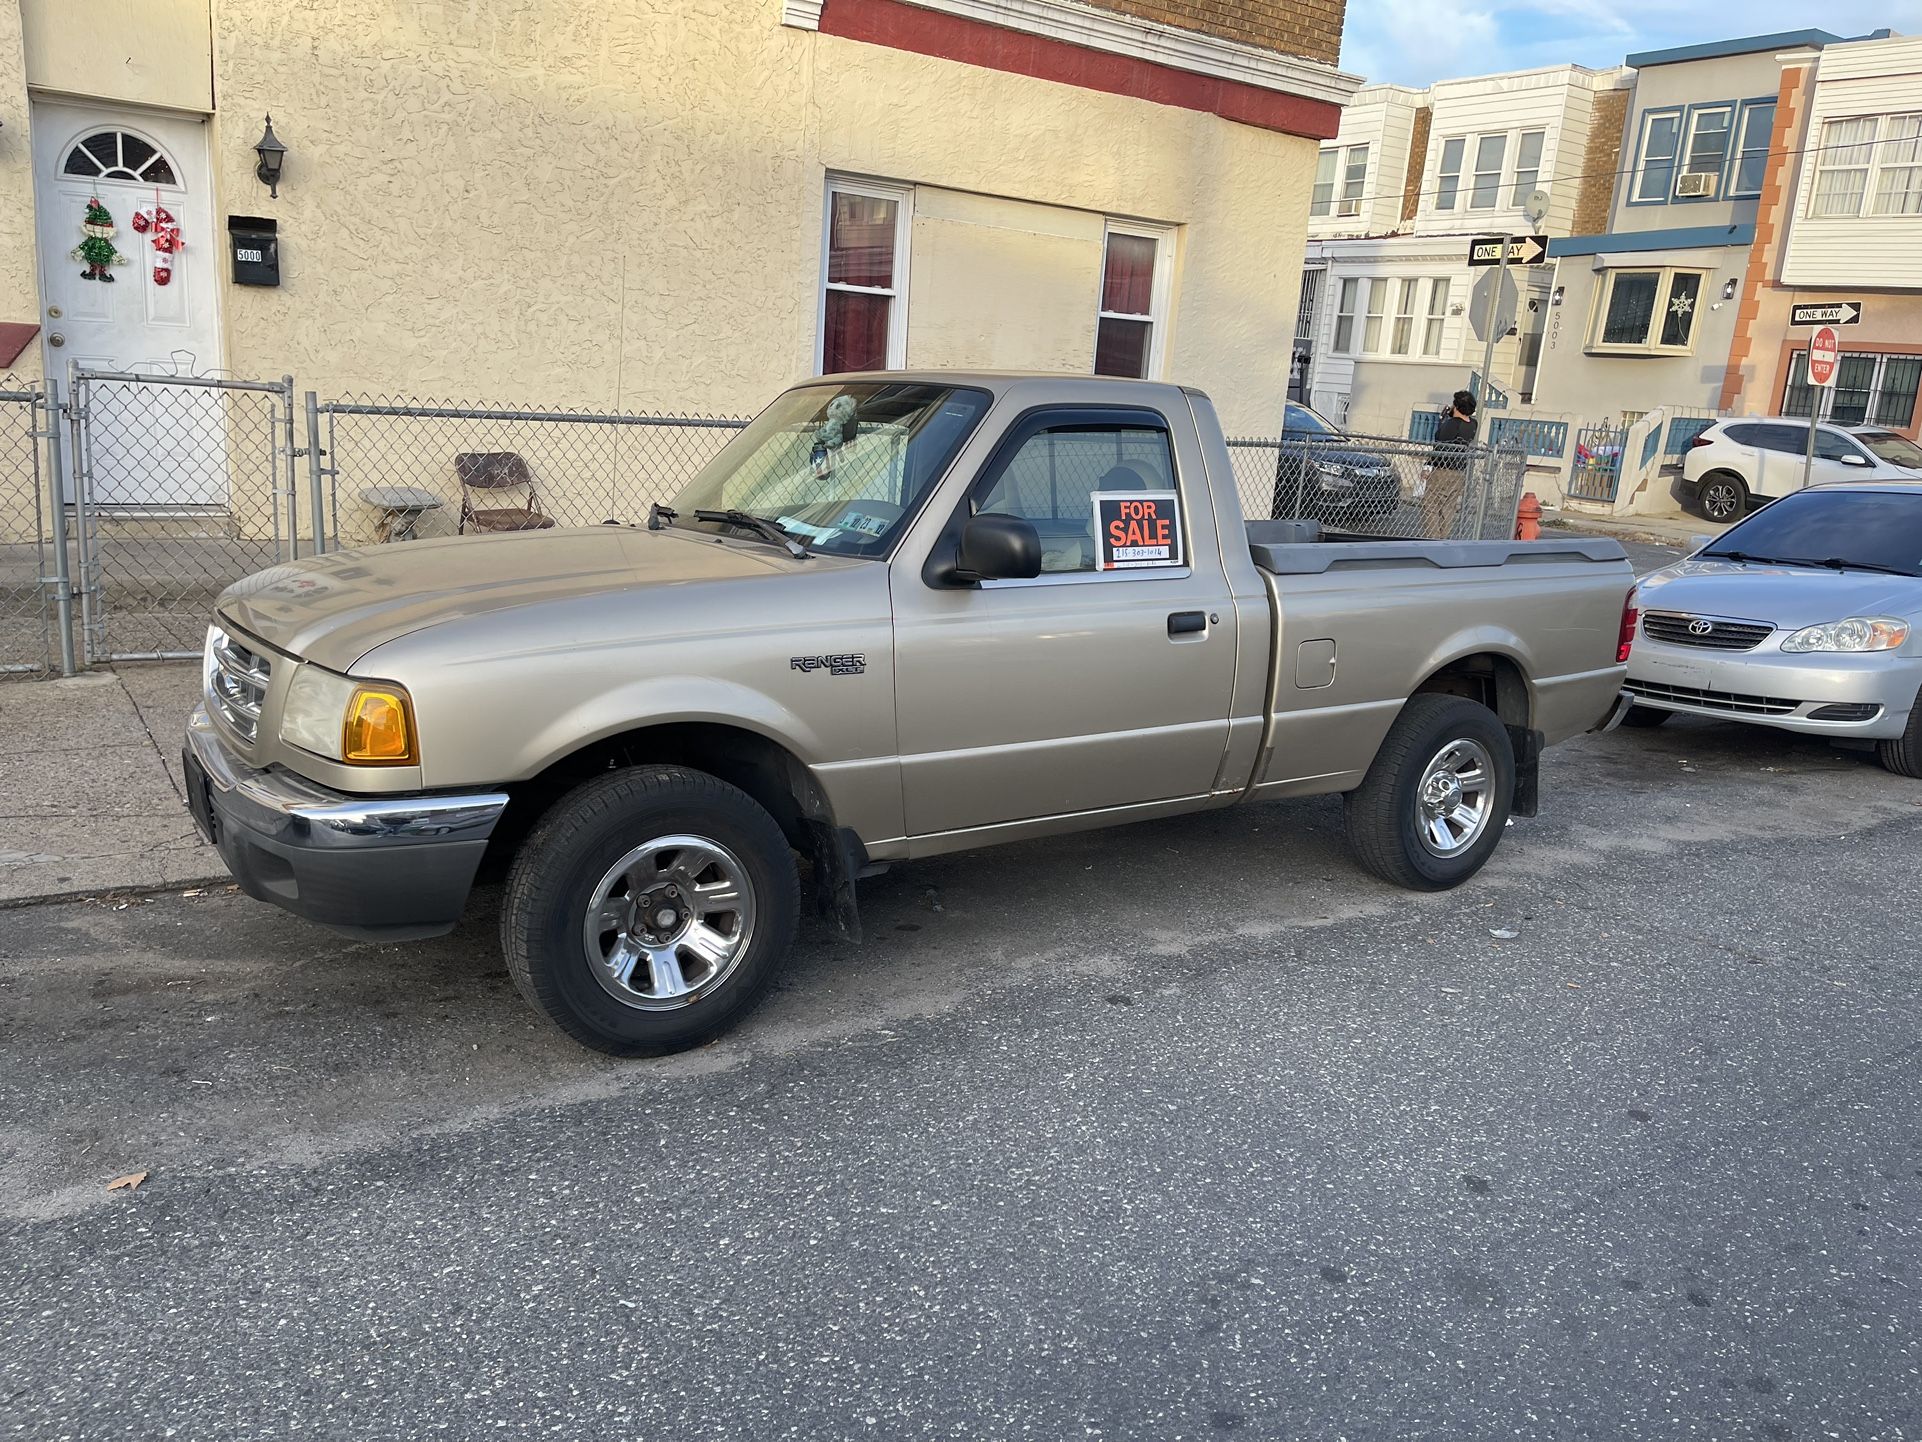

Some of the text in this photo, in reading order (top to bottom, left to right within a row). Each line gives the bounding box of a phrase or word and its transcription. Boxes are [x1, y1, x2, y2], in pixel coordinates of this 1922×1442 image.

[238, 250, 261, 261] 5000
[1476, 246, 1497, 258] ONE
[1798, 309, 1840, 320] ONE WAY
[1550, 311, 1561, 350] 5003
[1815, 337, 1835, 349] DO NOT
[1814, 363, 1831, 374] ENTER
[1120, 501, 1157, 520] FOR
[1109, 519, 1172, 547] SALE
[790, 653, 867, 673] RANGER
